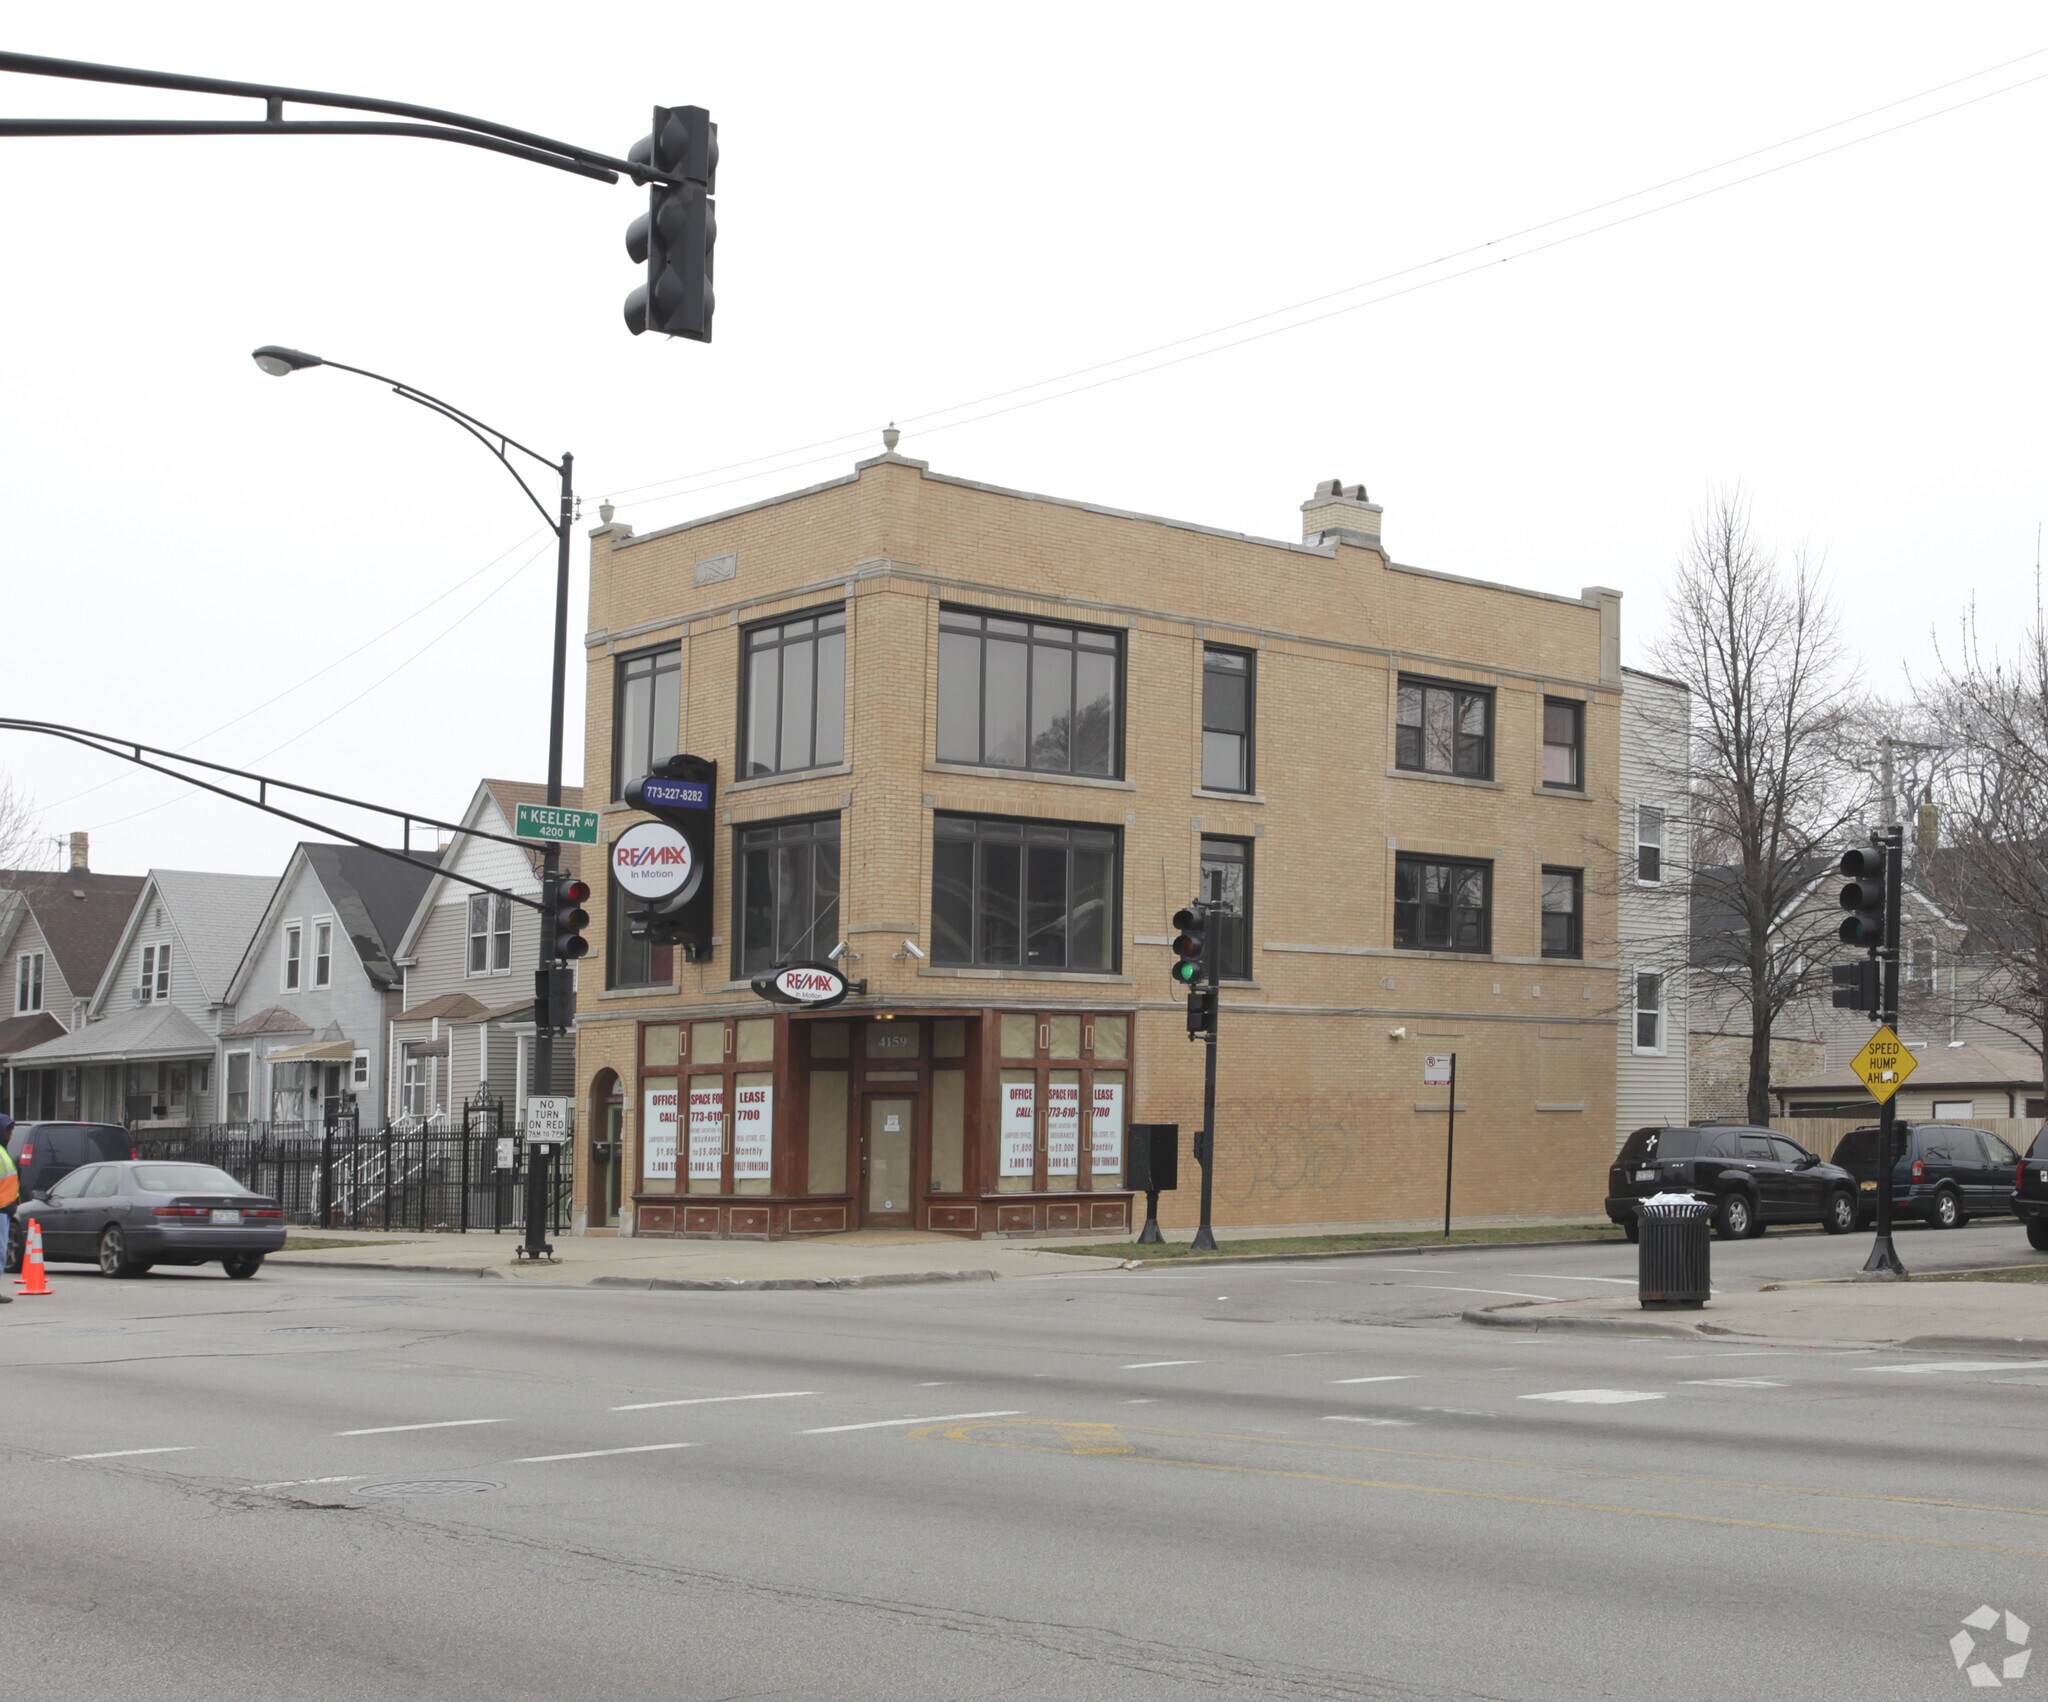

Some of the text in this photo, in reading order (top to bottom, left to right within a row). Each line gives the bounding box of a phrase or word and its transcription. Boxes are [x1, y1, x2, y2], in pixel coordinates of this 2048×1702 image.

[647, 786, 703, 802] 773-227-8282
[520, 809, 595, 828] N KEELER AV
[539, 826, 576, 839] 4200 W
[617, 846, 687, 868] RE/MAX
[631, 870, 674, 879] In Motion
[786, 973, 833, 992] RE/MAX
[878, 1036, 908, 1048] 4159
[1869, 1043, 1899, 1054] SPEED
[1870, 1058, 1897, 1069] HUMP
[652, 1094, 677, 1106] OFFICE
[690, 1094, 710, 1105] SPACE
[740, 1091, 765, 1104] LEASE
[1010, 1089, 1114, 1100] OFFICE SPACE FOR LEASE
[540, 1100, 554, 1108] NO
[536, 1110, 558, 1118] TURN
[737, 1109, 760, 1121] 7700
[529, 1120, 564, 1129] ON RED
[551, 1130, 565, 1138] 7PM
[735, 1147, 763, 1156] Monthly
